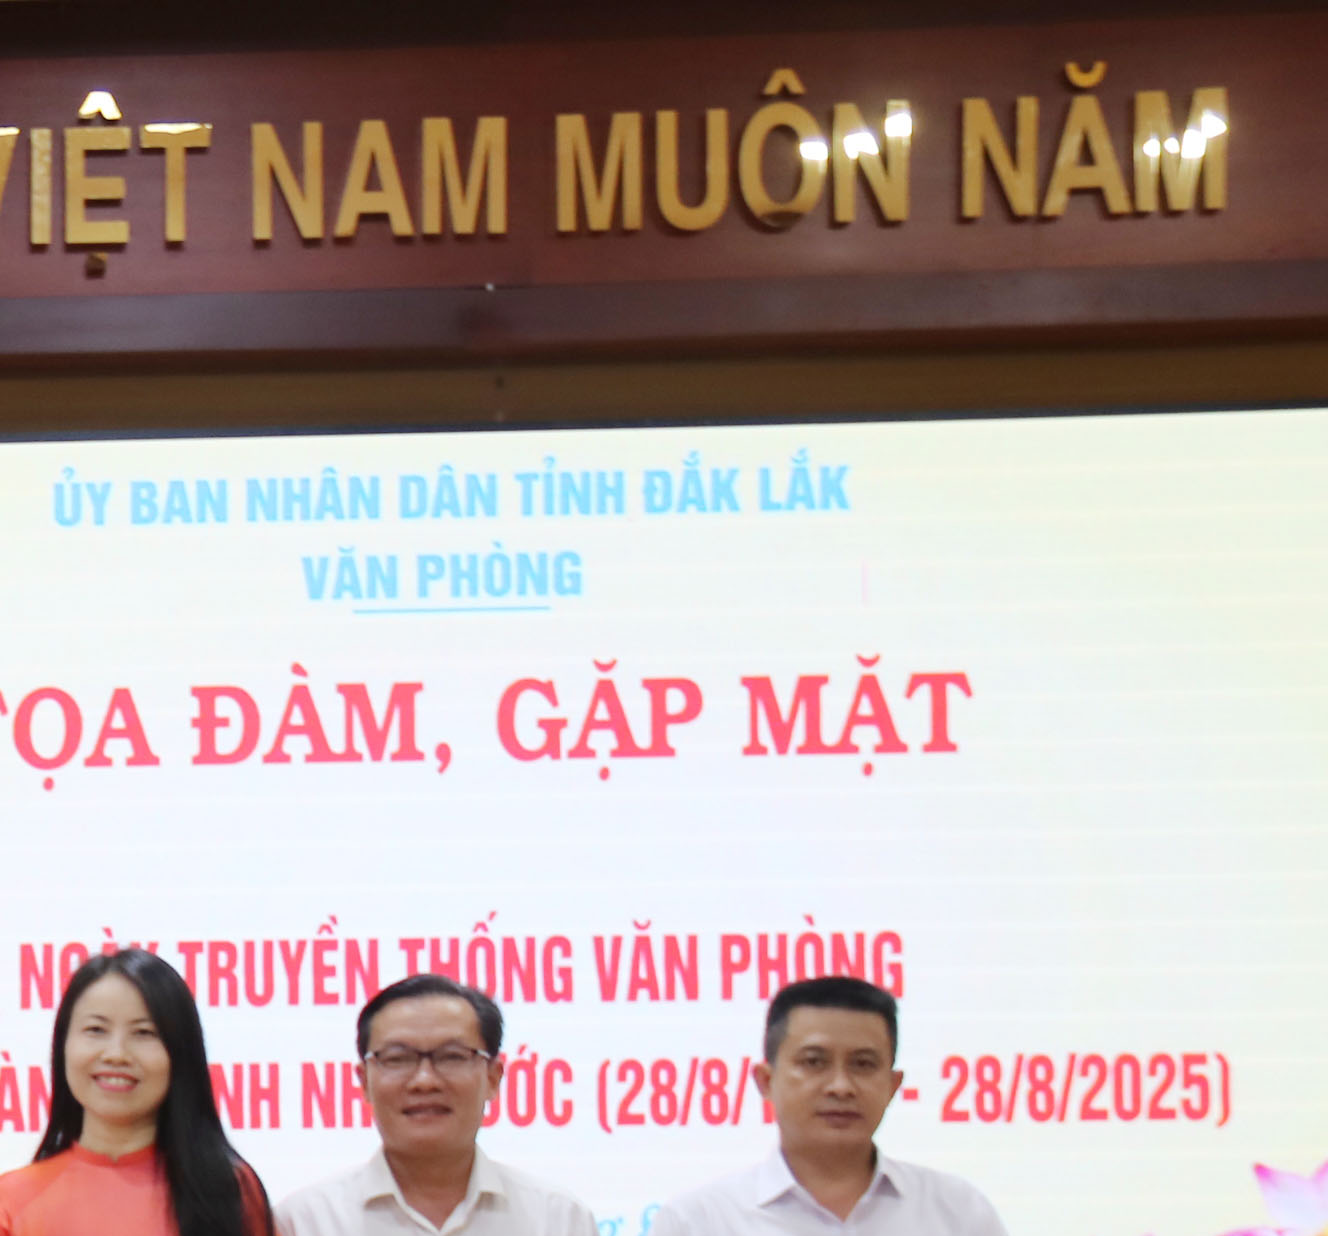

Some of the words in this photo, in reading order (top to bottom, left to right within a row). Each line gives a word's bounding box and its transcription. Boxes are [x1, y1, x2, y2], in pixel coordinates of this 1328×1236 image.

[251, 115, 508, 242] NAM
[555, 67, 912, 231] MUÔN
[961, 60, 1229, 218] NĂM
[52, 467, 113, 527] ỦY
[130, 479, 229, 526] BAN
[245, 466, 381, 521] NHÂN
[398, 464, 499, 519] DÂN
[514, 456, 625, 517] TỈNH
[642, 448, 741, 514] ĐẮK
[759, 447, 850, 512] LẮK
[302, 546, 399, 601] VĂN
[416, 541, 584, 599] PHÒNG
[190, 663, 454, 774] ĐÀM,
[495, 659, 705, 781] GẶP
[740, 653, 974, 777] MẶT
[177, 915, 379, 1008] TRUYỀN
[398, 910, 574, 1004] THỐNG
[592, 920, 700, 1002] VĂN
[720, 914, 904, 1001] PHÒNG
[901, 1087, 920, 1101] -
[939, 1052, 1233, 1129] 28/8/2025)
